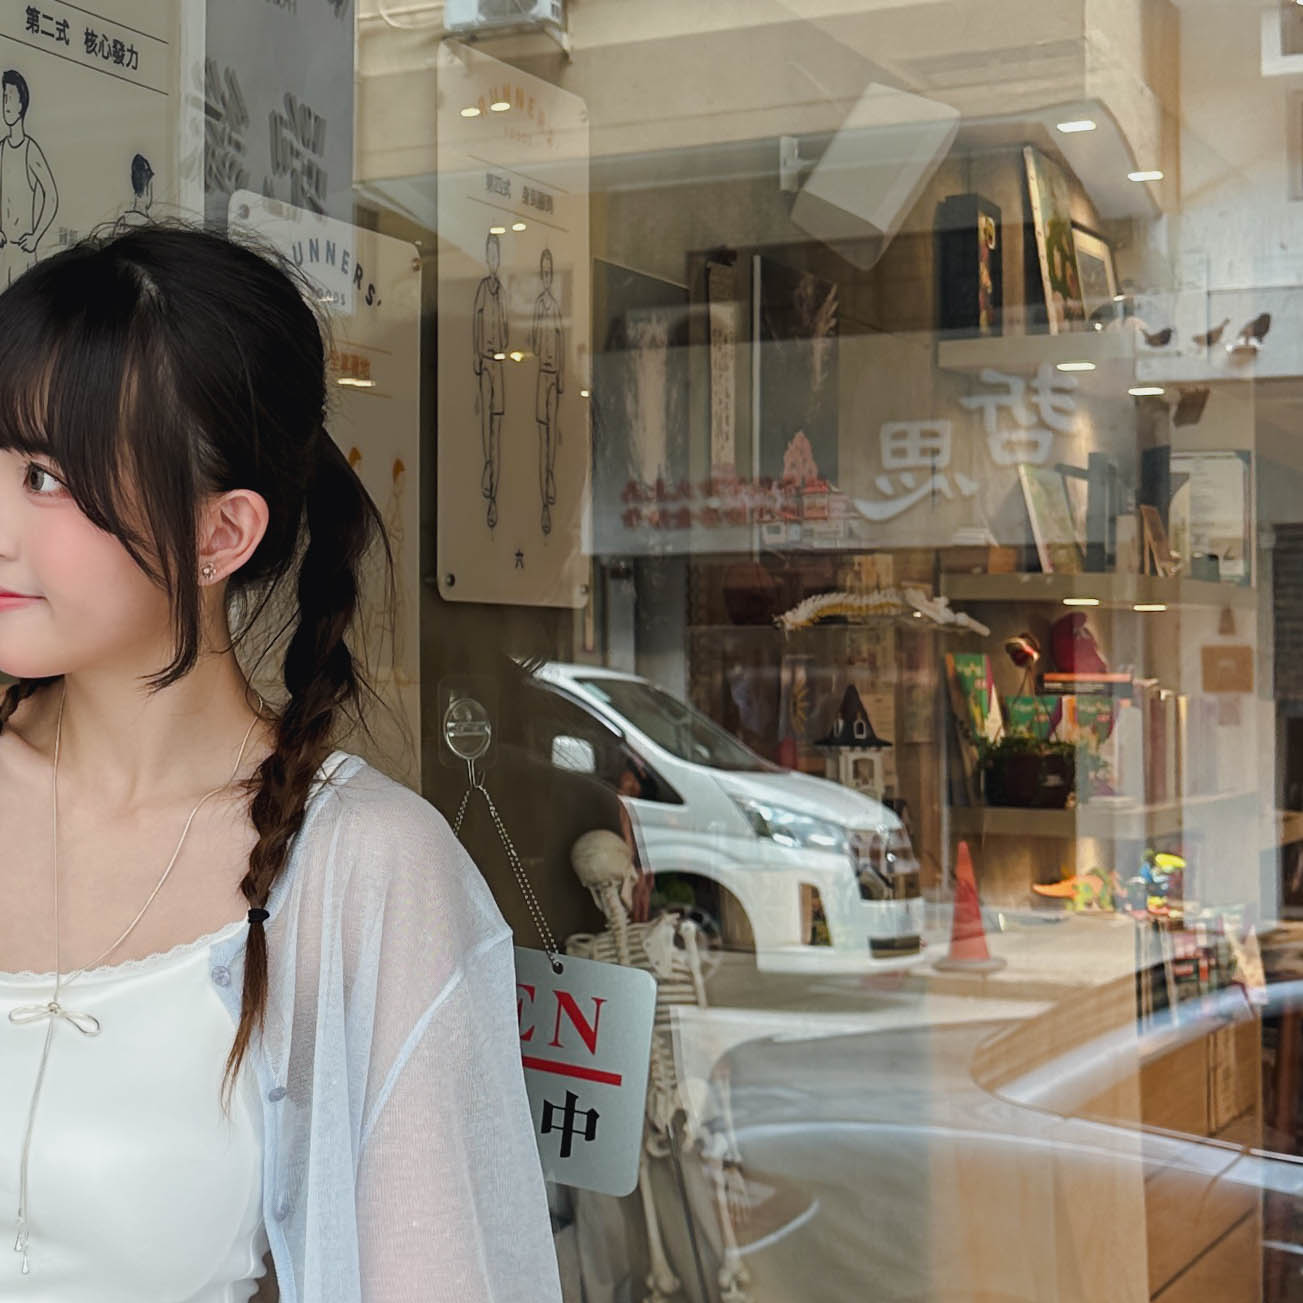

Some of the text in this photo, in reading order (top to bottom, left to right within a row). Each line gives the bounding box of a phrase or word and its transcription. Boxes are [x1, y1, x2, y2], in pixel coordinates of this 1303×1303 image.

[25, 5, 139, 71] 第二式 核心發力
